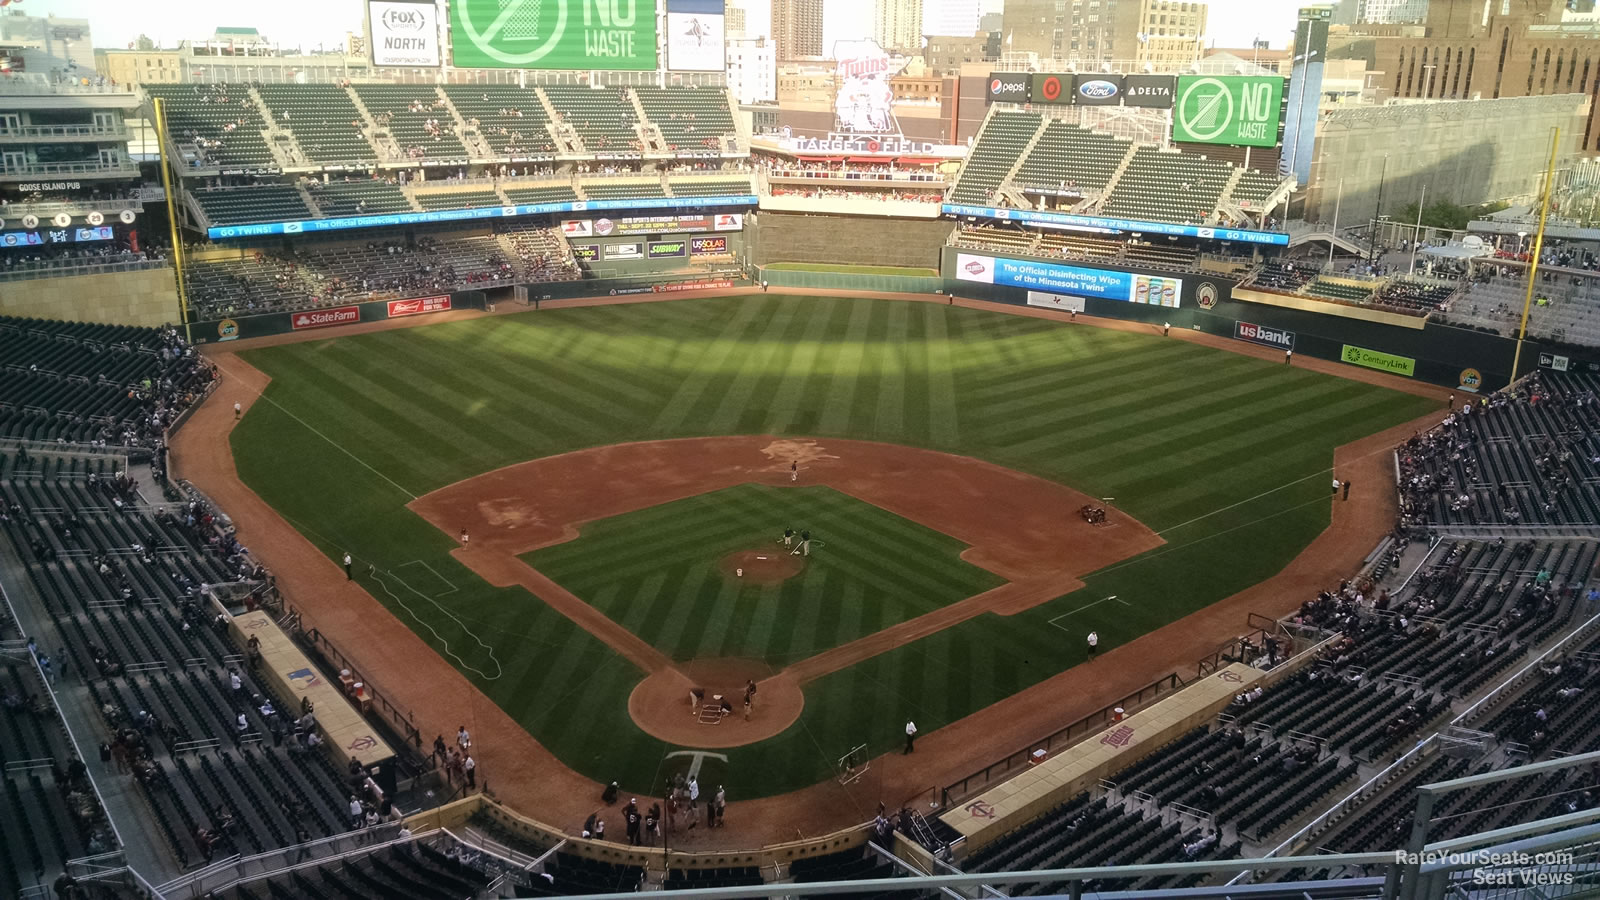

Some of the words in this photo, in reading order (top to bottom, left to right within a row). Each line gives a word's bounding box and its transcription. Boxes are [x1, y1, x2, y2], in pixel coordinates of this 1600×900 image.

[391, 12, 416, 23] FOX
[384, 36, 426, 50] NORTH
[585, 29, 636, 58] WASTE
[840, 57, 889, 80] Twins
[1002, 82, 1025, 92] pepsi
[1086, 84, 1110, 96] Ford
[1138, 86, 1170, 96] DELTA
[1240, 82, 1272, 121] NO
[1238, 122, 1266, 139] WASTE
[797, 140, 866, 151] TARGET
[884, 141, 934, 153] FIELD
[330, 219, 356, 228] Official
[358, 216, 399, 226] Disinfecting
[401, 214, 418, 223] Wipe
[440, 211, 473, 220] Minnesota
[1053, 215, 1089, 225] Disinfecting
[1091, 218, 1106, 226] Wipe
[1129, 222, 1162, 232] Minnesota
[238, 226, 272, 235] TWINS!
[1242, 233, 1273, 242] TWINS!
[650, 244, 684, 253] SUBWAY
[1020, 266, 1046, 276] Official
[1049, 270, 1096, 282] Disinfecting
[1099, 275, 1120, 284] Wipe
[1039, 278, 1078, 288] Minnesota
[1081, 282, 1104, 292] Twins
[1240, 325, 1290, 345] usbank
[1362, 354, 1408, 370] CenturyLink
[1463, 375, 1478, 385] VOTE
[1100, 726, 1134, 748] Twins
